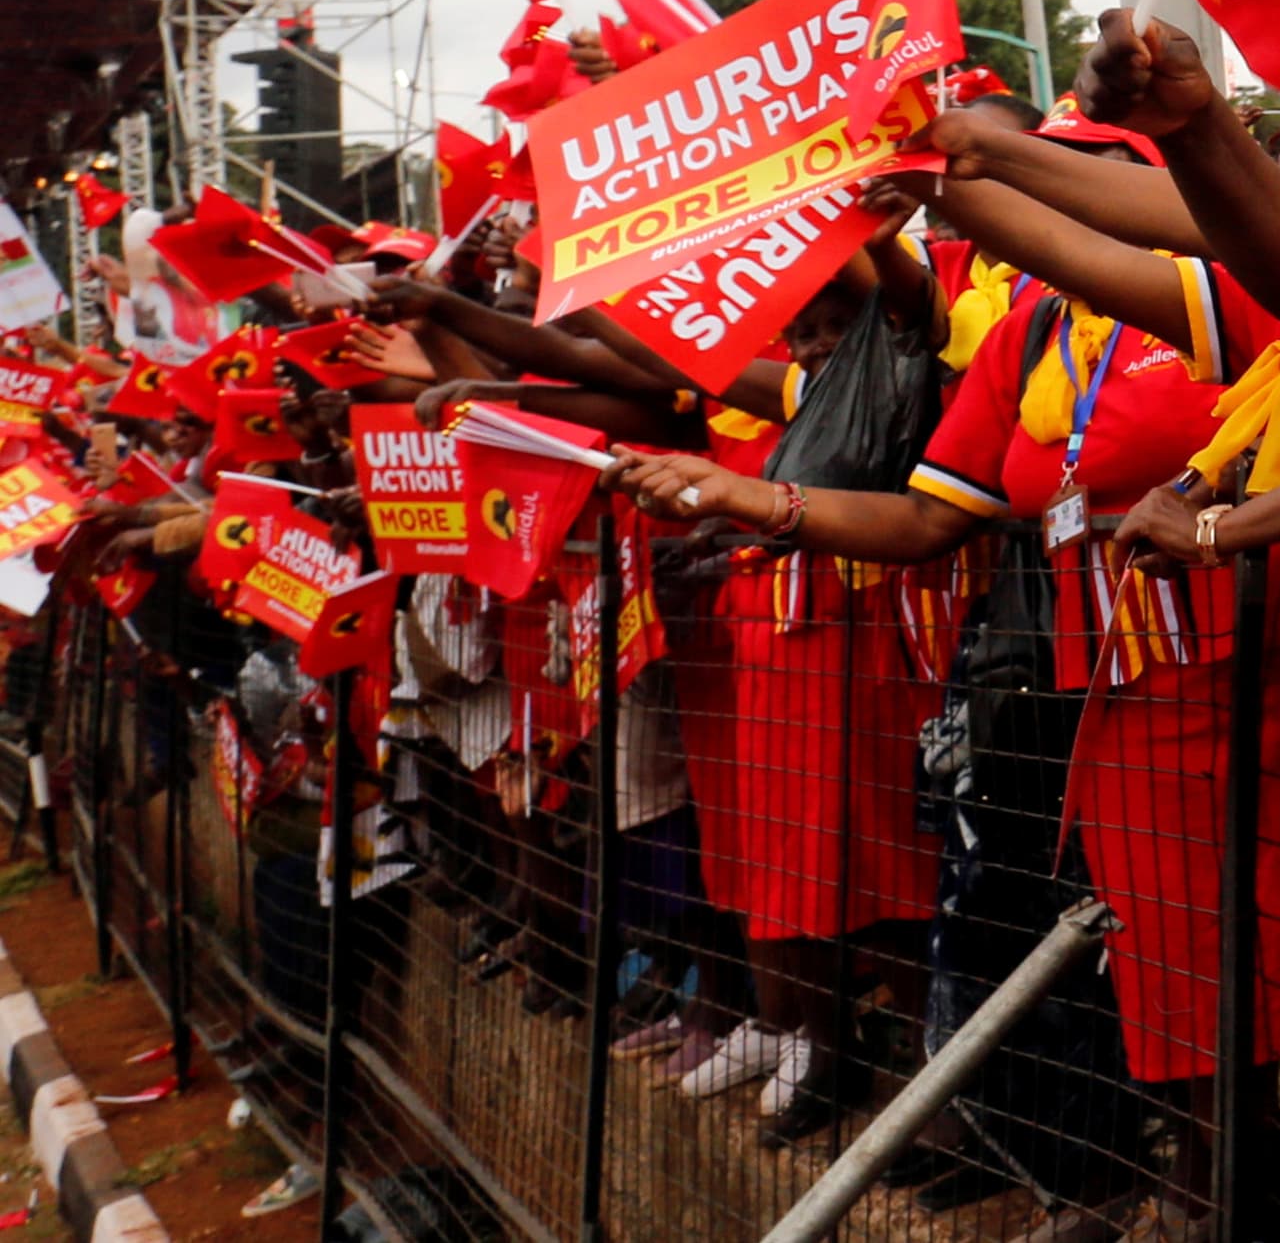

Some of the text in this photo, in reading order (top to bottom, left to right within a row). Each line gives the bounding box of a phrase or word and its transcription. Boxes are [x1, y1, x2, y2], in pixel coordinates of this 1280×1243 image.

[571, 117, 753, 220] ACTION
[574, 174, 752, 267] MORE
[363, 431, 459, 468] UHUR
[371, 470, 448, 493] ACTION
[378, 508, 450, 532] MORE
[266, 544, 316, 586] CTION
[252, 566, 301, 604] MORE
